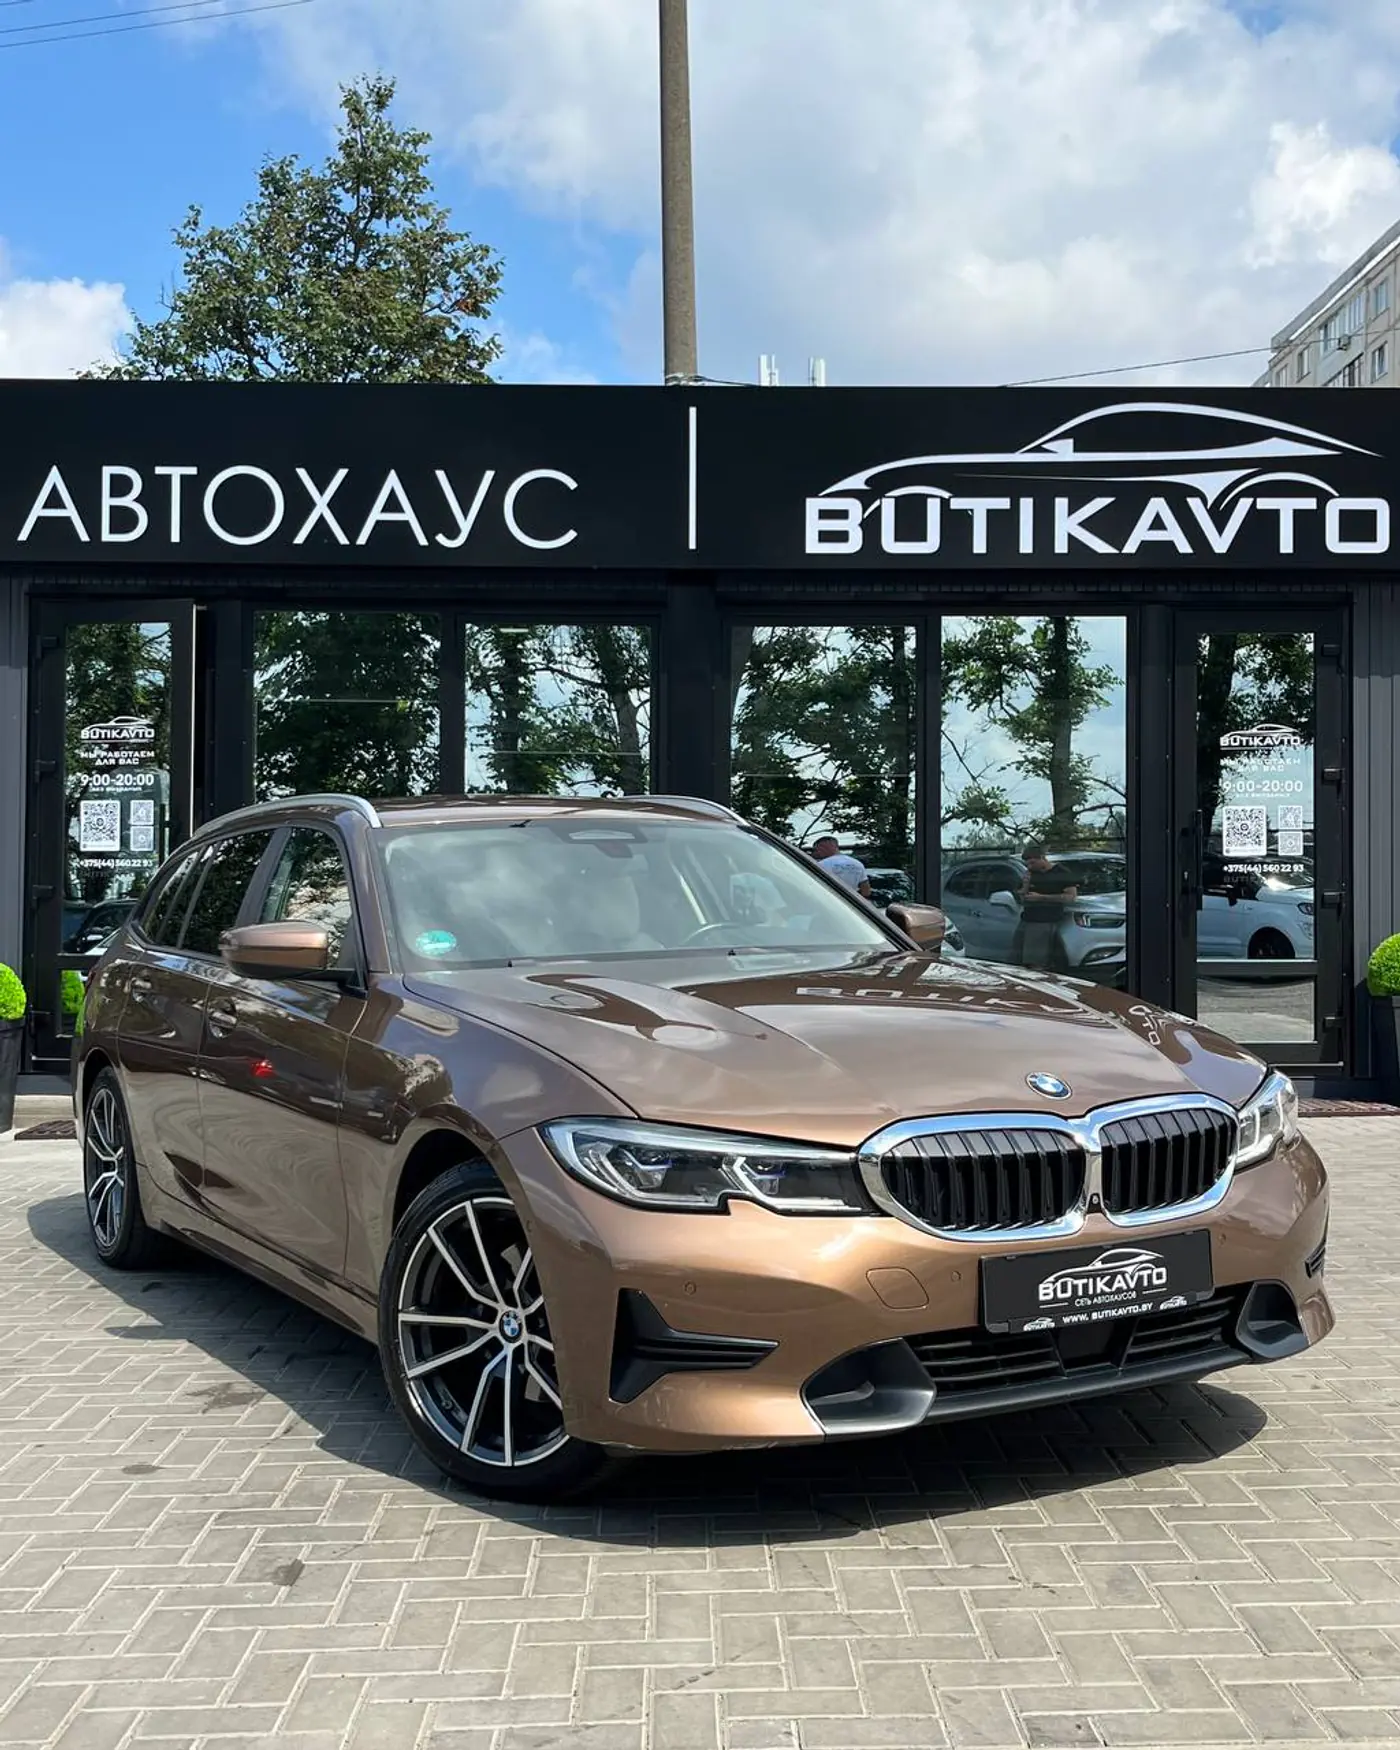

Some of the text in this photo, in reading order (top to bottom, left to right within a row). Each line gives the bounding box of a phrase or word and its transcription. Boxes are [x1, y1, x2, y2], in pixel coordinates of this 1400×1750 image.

[17, 464, 579, 550] АВТОХАУС
[804, 495, 1391, 555] BUTIKAVTO
[80, 728, 155, 740] BUTIKAVTO
[1219, 736, 1301, 747] BUTIKAVTO
[80, 773, 155, 787] 9:00-20:00
[1222, 780, 1304, 793] 9:00-20:00
[1038, 1266, 1168, 1301] BUTIKAVTO
[1091, 1302, 1154, 1321] BUTIKAVTO.BY
